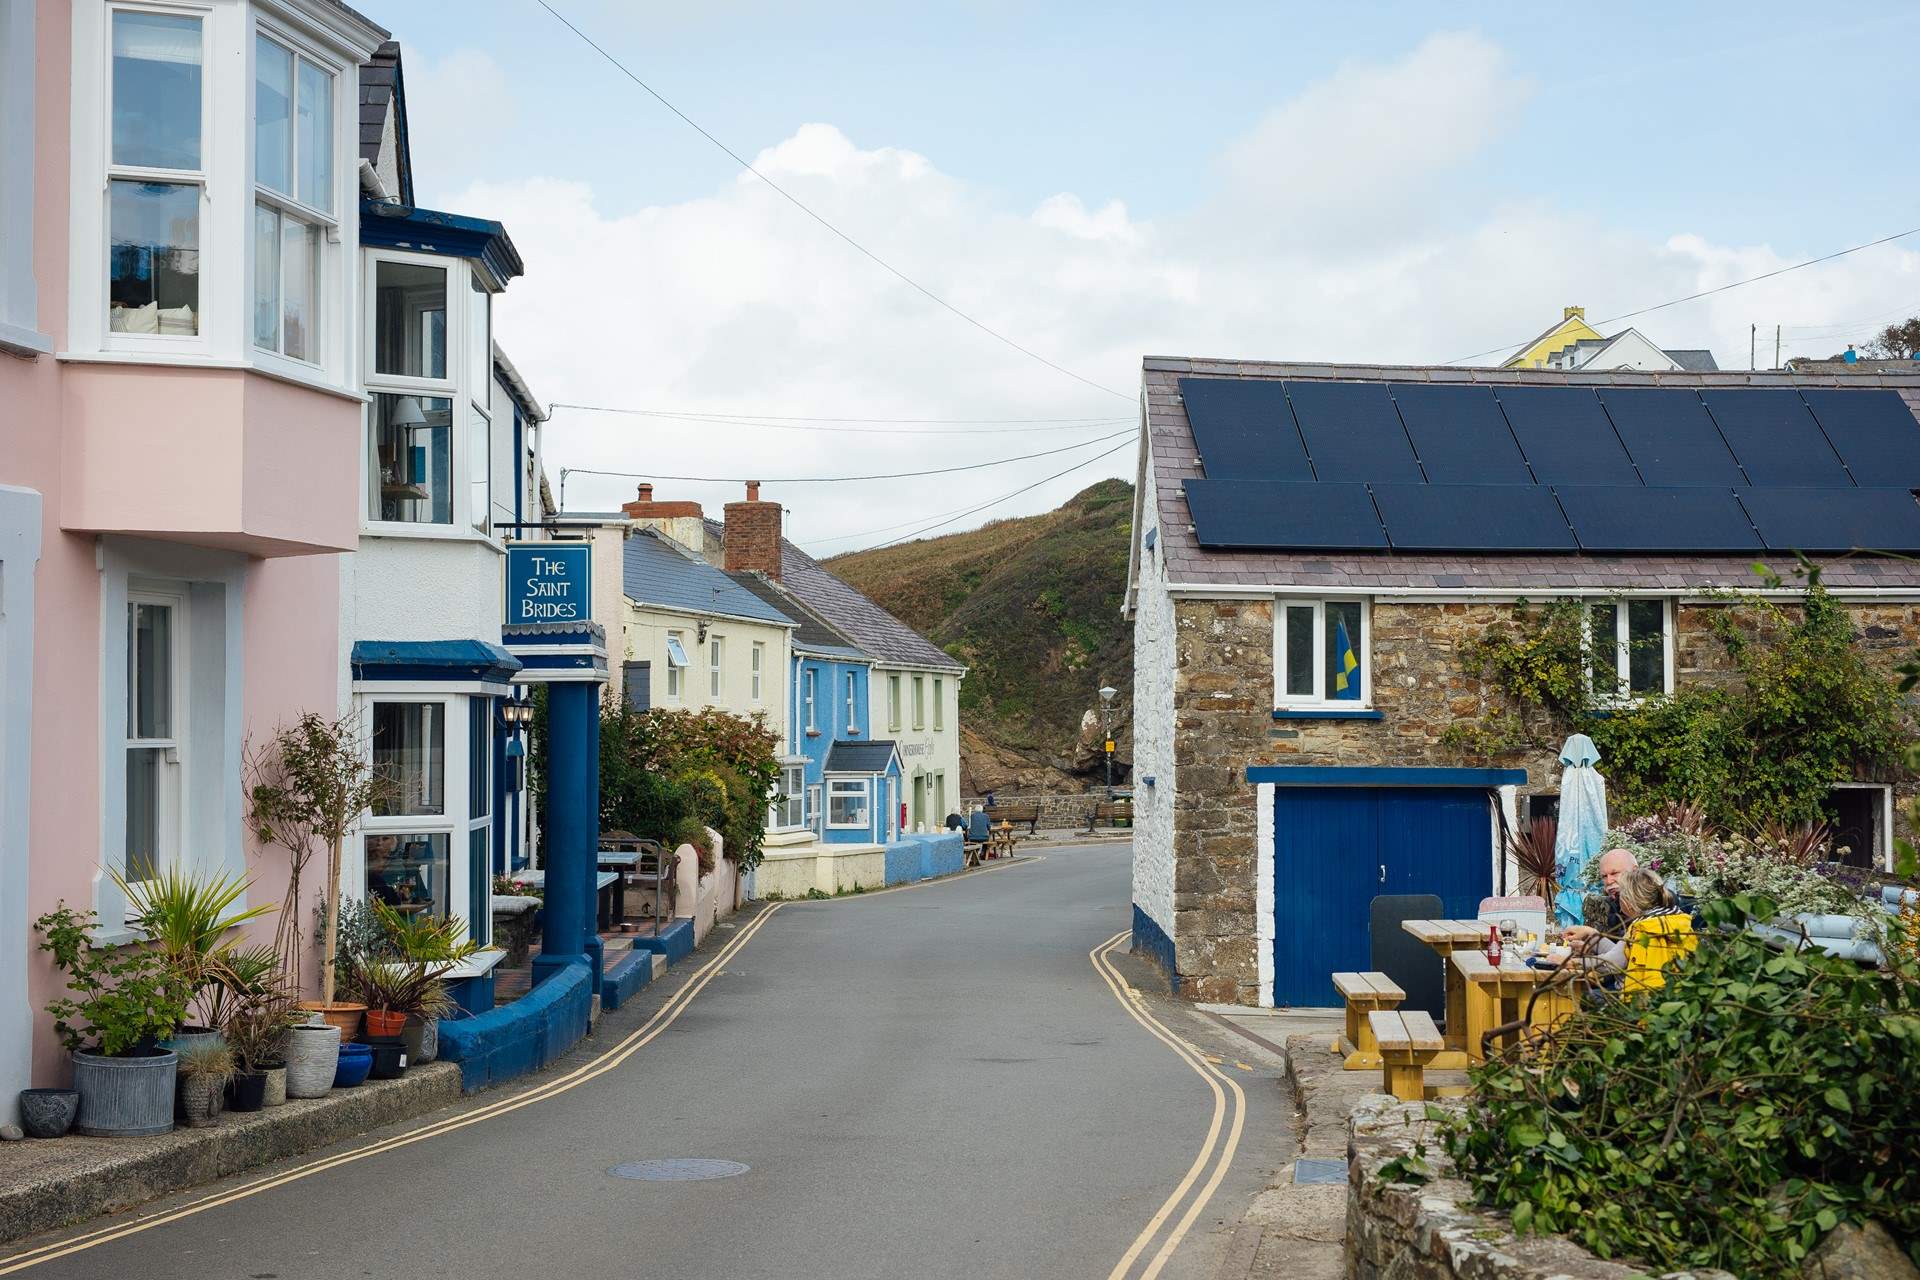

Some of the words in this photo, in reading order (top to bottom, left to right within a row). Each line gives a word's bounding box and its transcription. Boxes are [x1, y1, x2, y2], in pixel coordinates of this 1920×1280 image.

[531, 557, 566, 576] THE
[526, 578, 571, 597] SAINT
[521, 599, 577, 618] BRIDES
